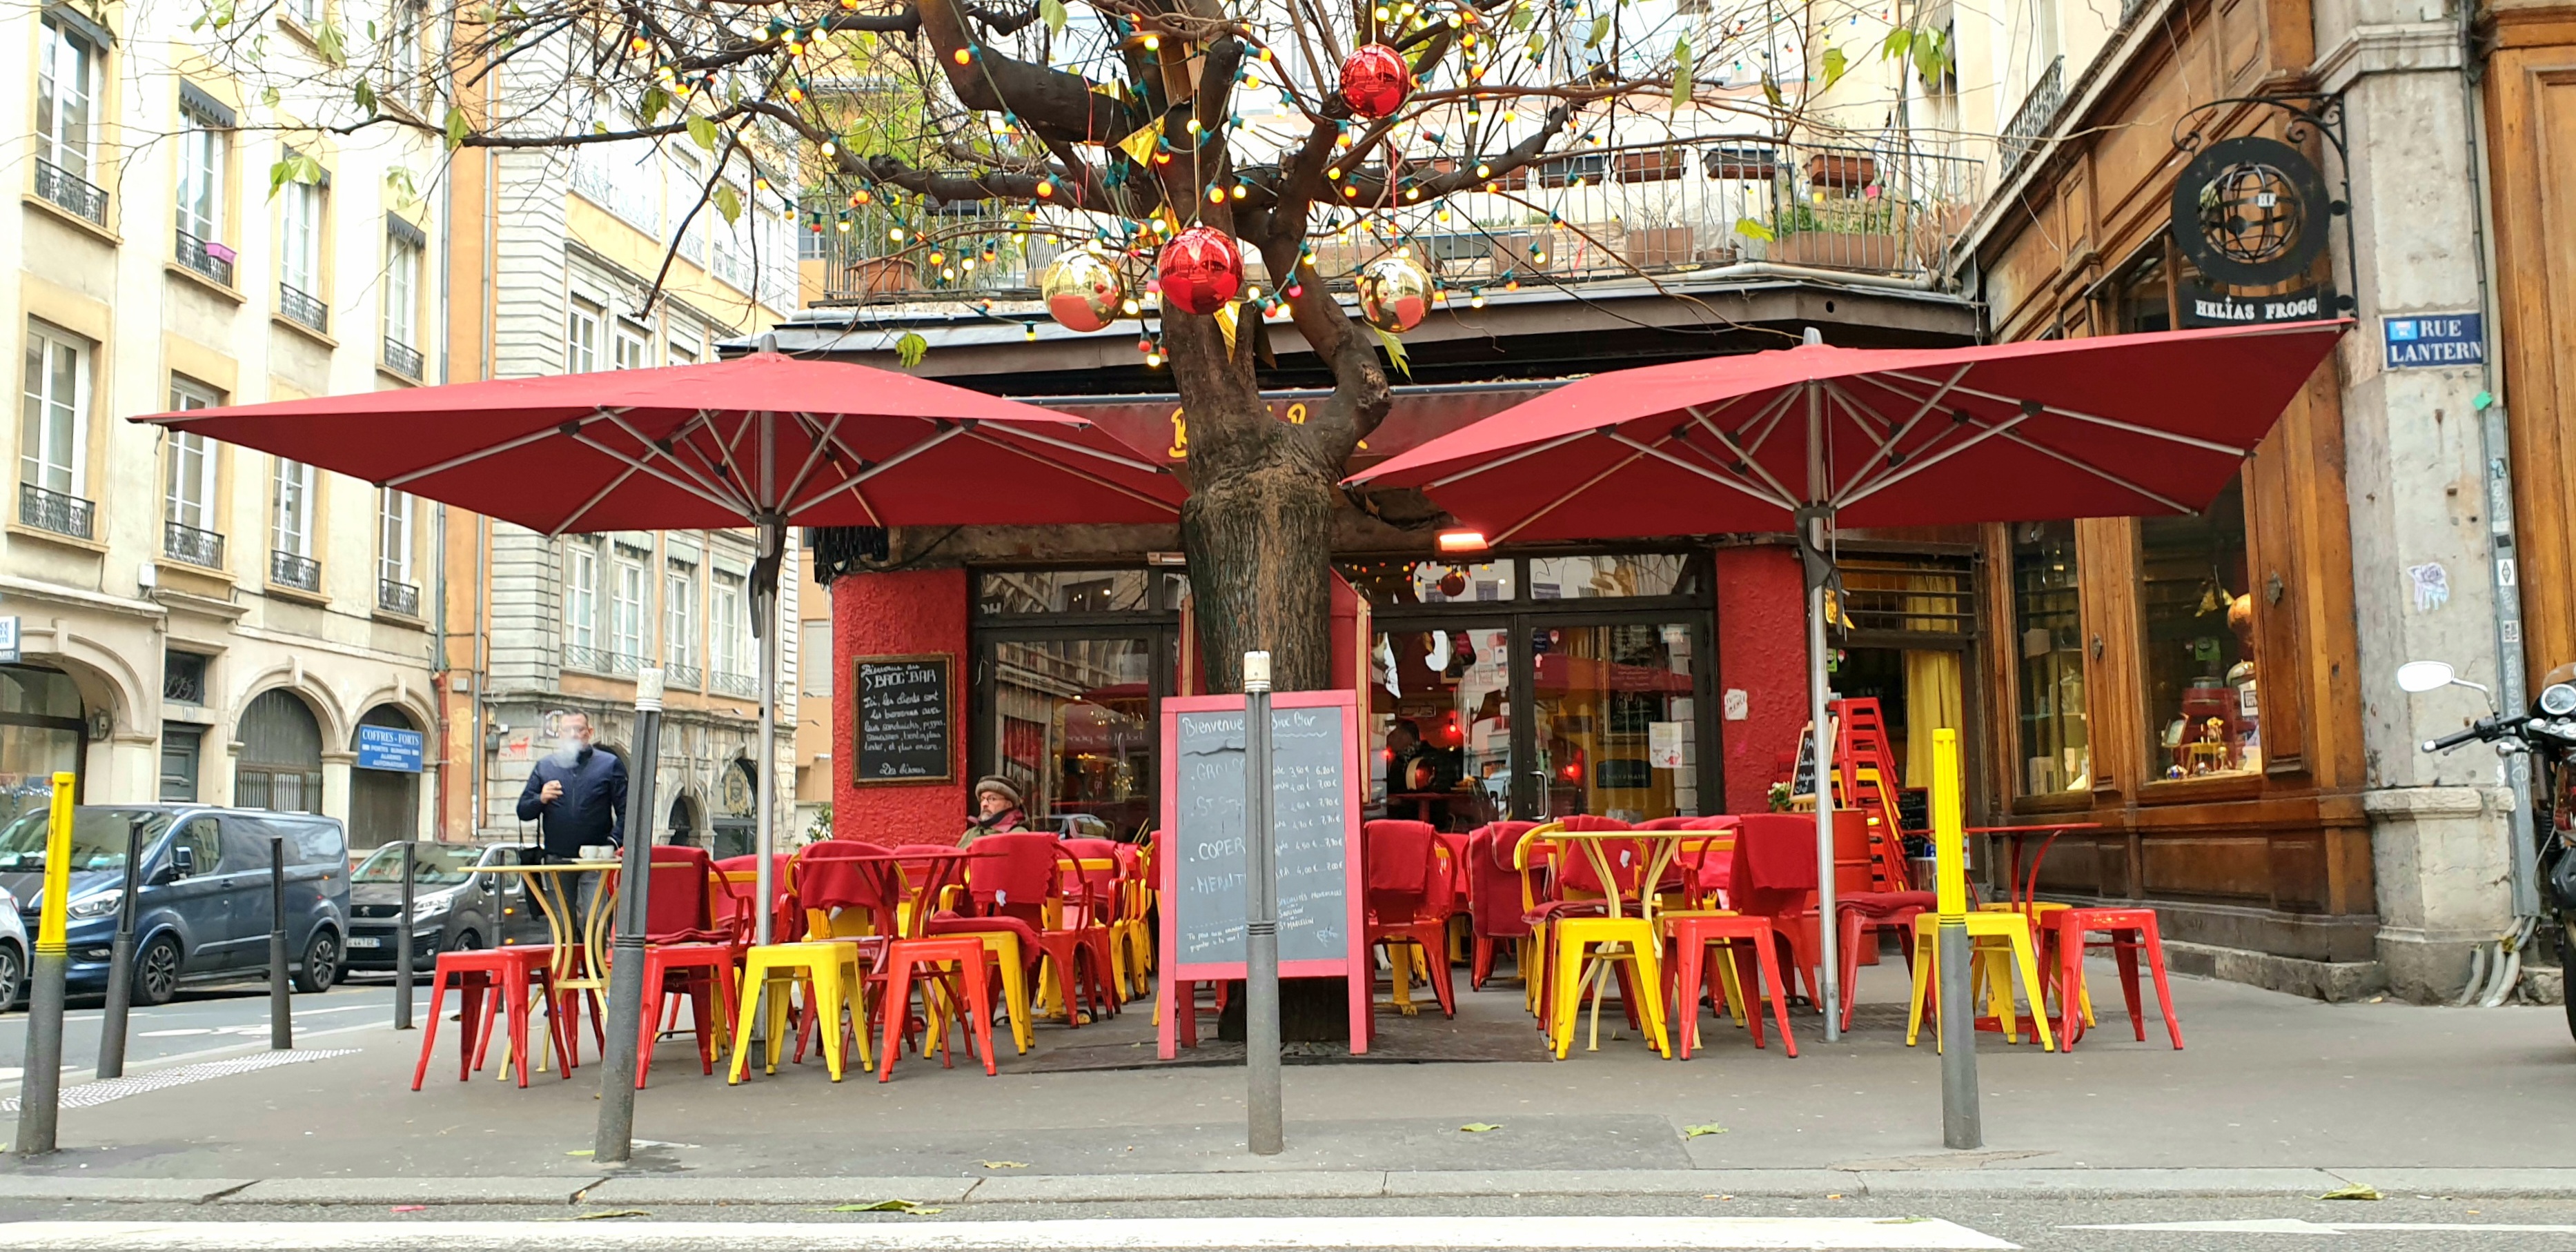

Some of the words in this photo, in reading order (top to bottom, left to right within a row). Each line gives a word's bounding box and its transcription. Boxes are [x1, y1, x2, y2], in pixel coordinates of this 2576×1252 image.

[2195, 295, 2255, 320] HELIAS
[2265, 297, 2318, 319] FROGG
[2420, 319, 2461, 337] RUE
[1182, 717, 1245, 737] Bienvenue
